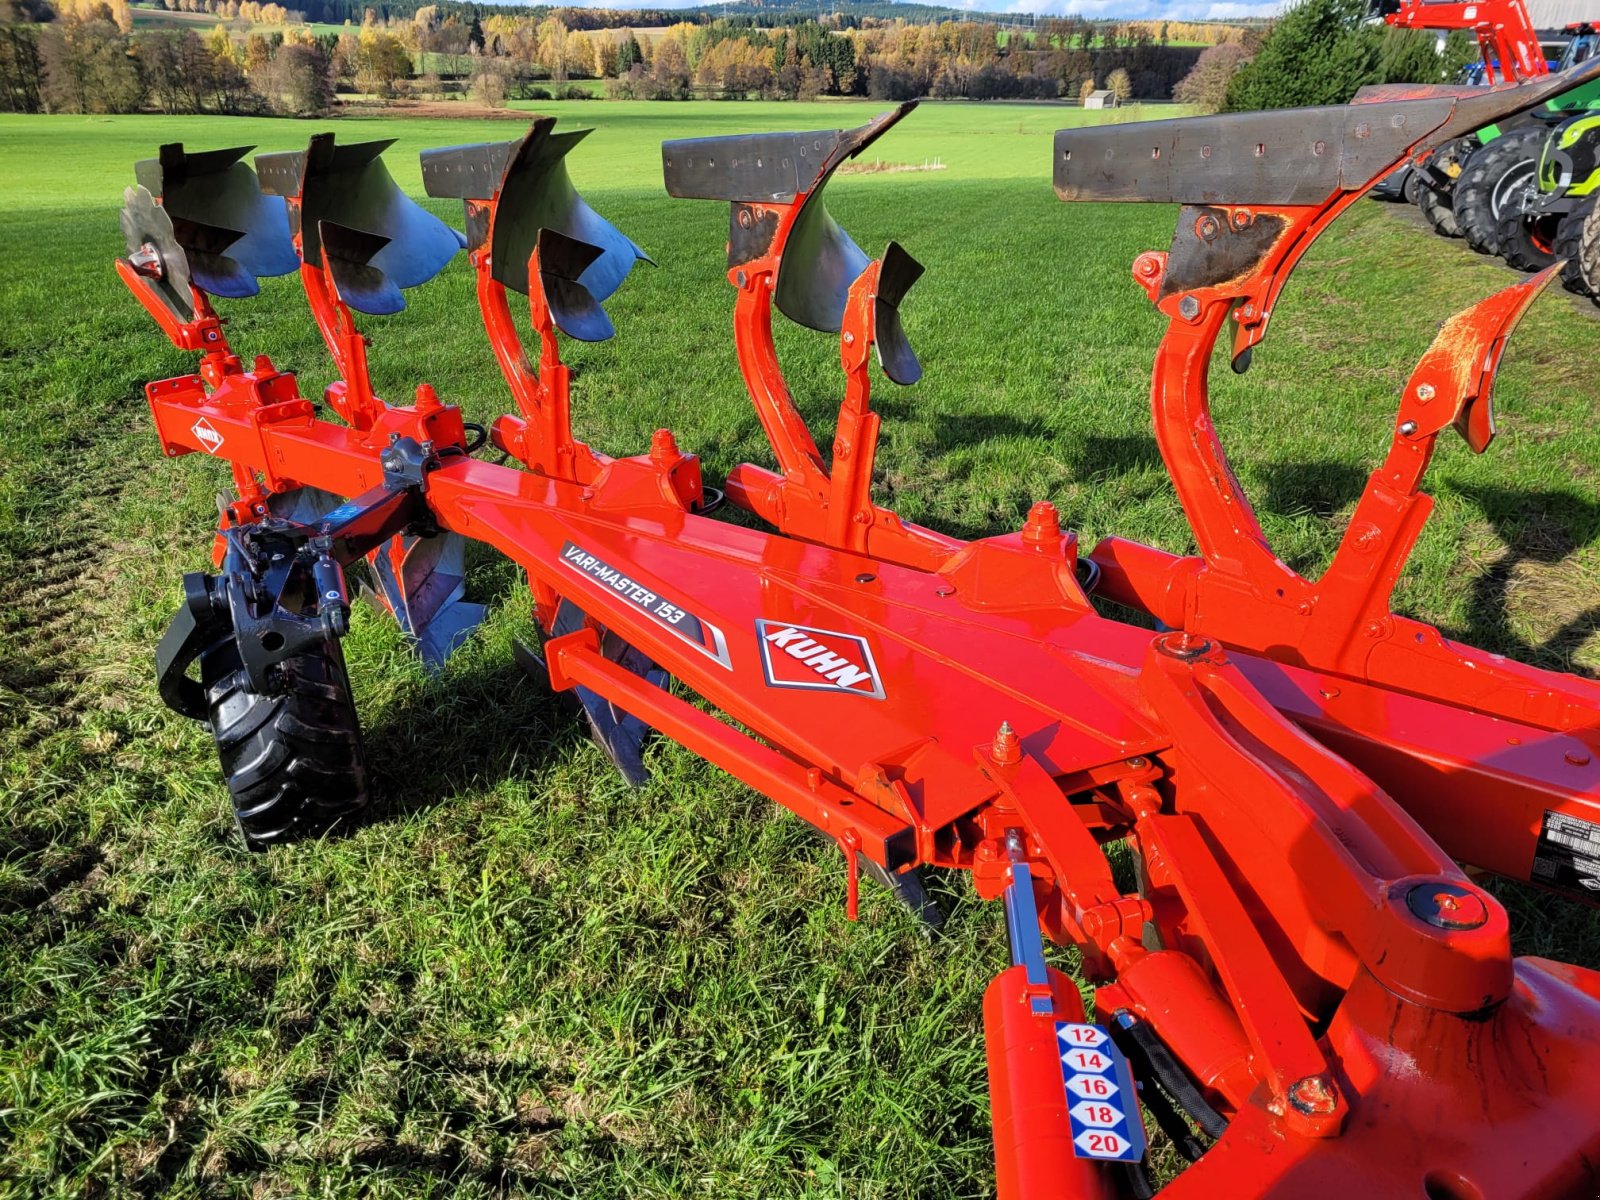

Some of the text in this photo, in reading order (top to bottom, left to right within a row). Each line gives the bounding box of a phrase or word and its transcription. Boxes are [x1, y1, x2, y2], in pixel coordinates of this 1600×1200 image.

[565, 546, 686, 624] VARI-MASTER 153
[764, 627, 872, 687] KUHN
[1071, 1028, 1097, 1043] 12
[1075, 1053, 1102, 1068] 14
[1080, 1079, 1108, 1095] 16
[1085, 1106, 1113, 1123] 18
[1088, 1134, 1119, 1153] 20
